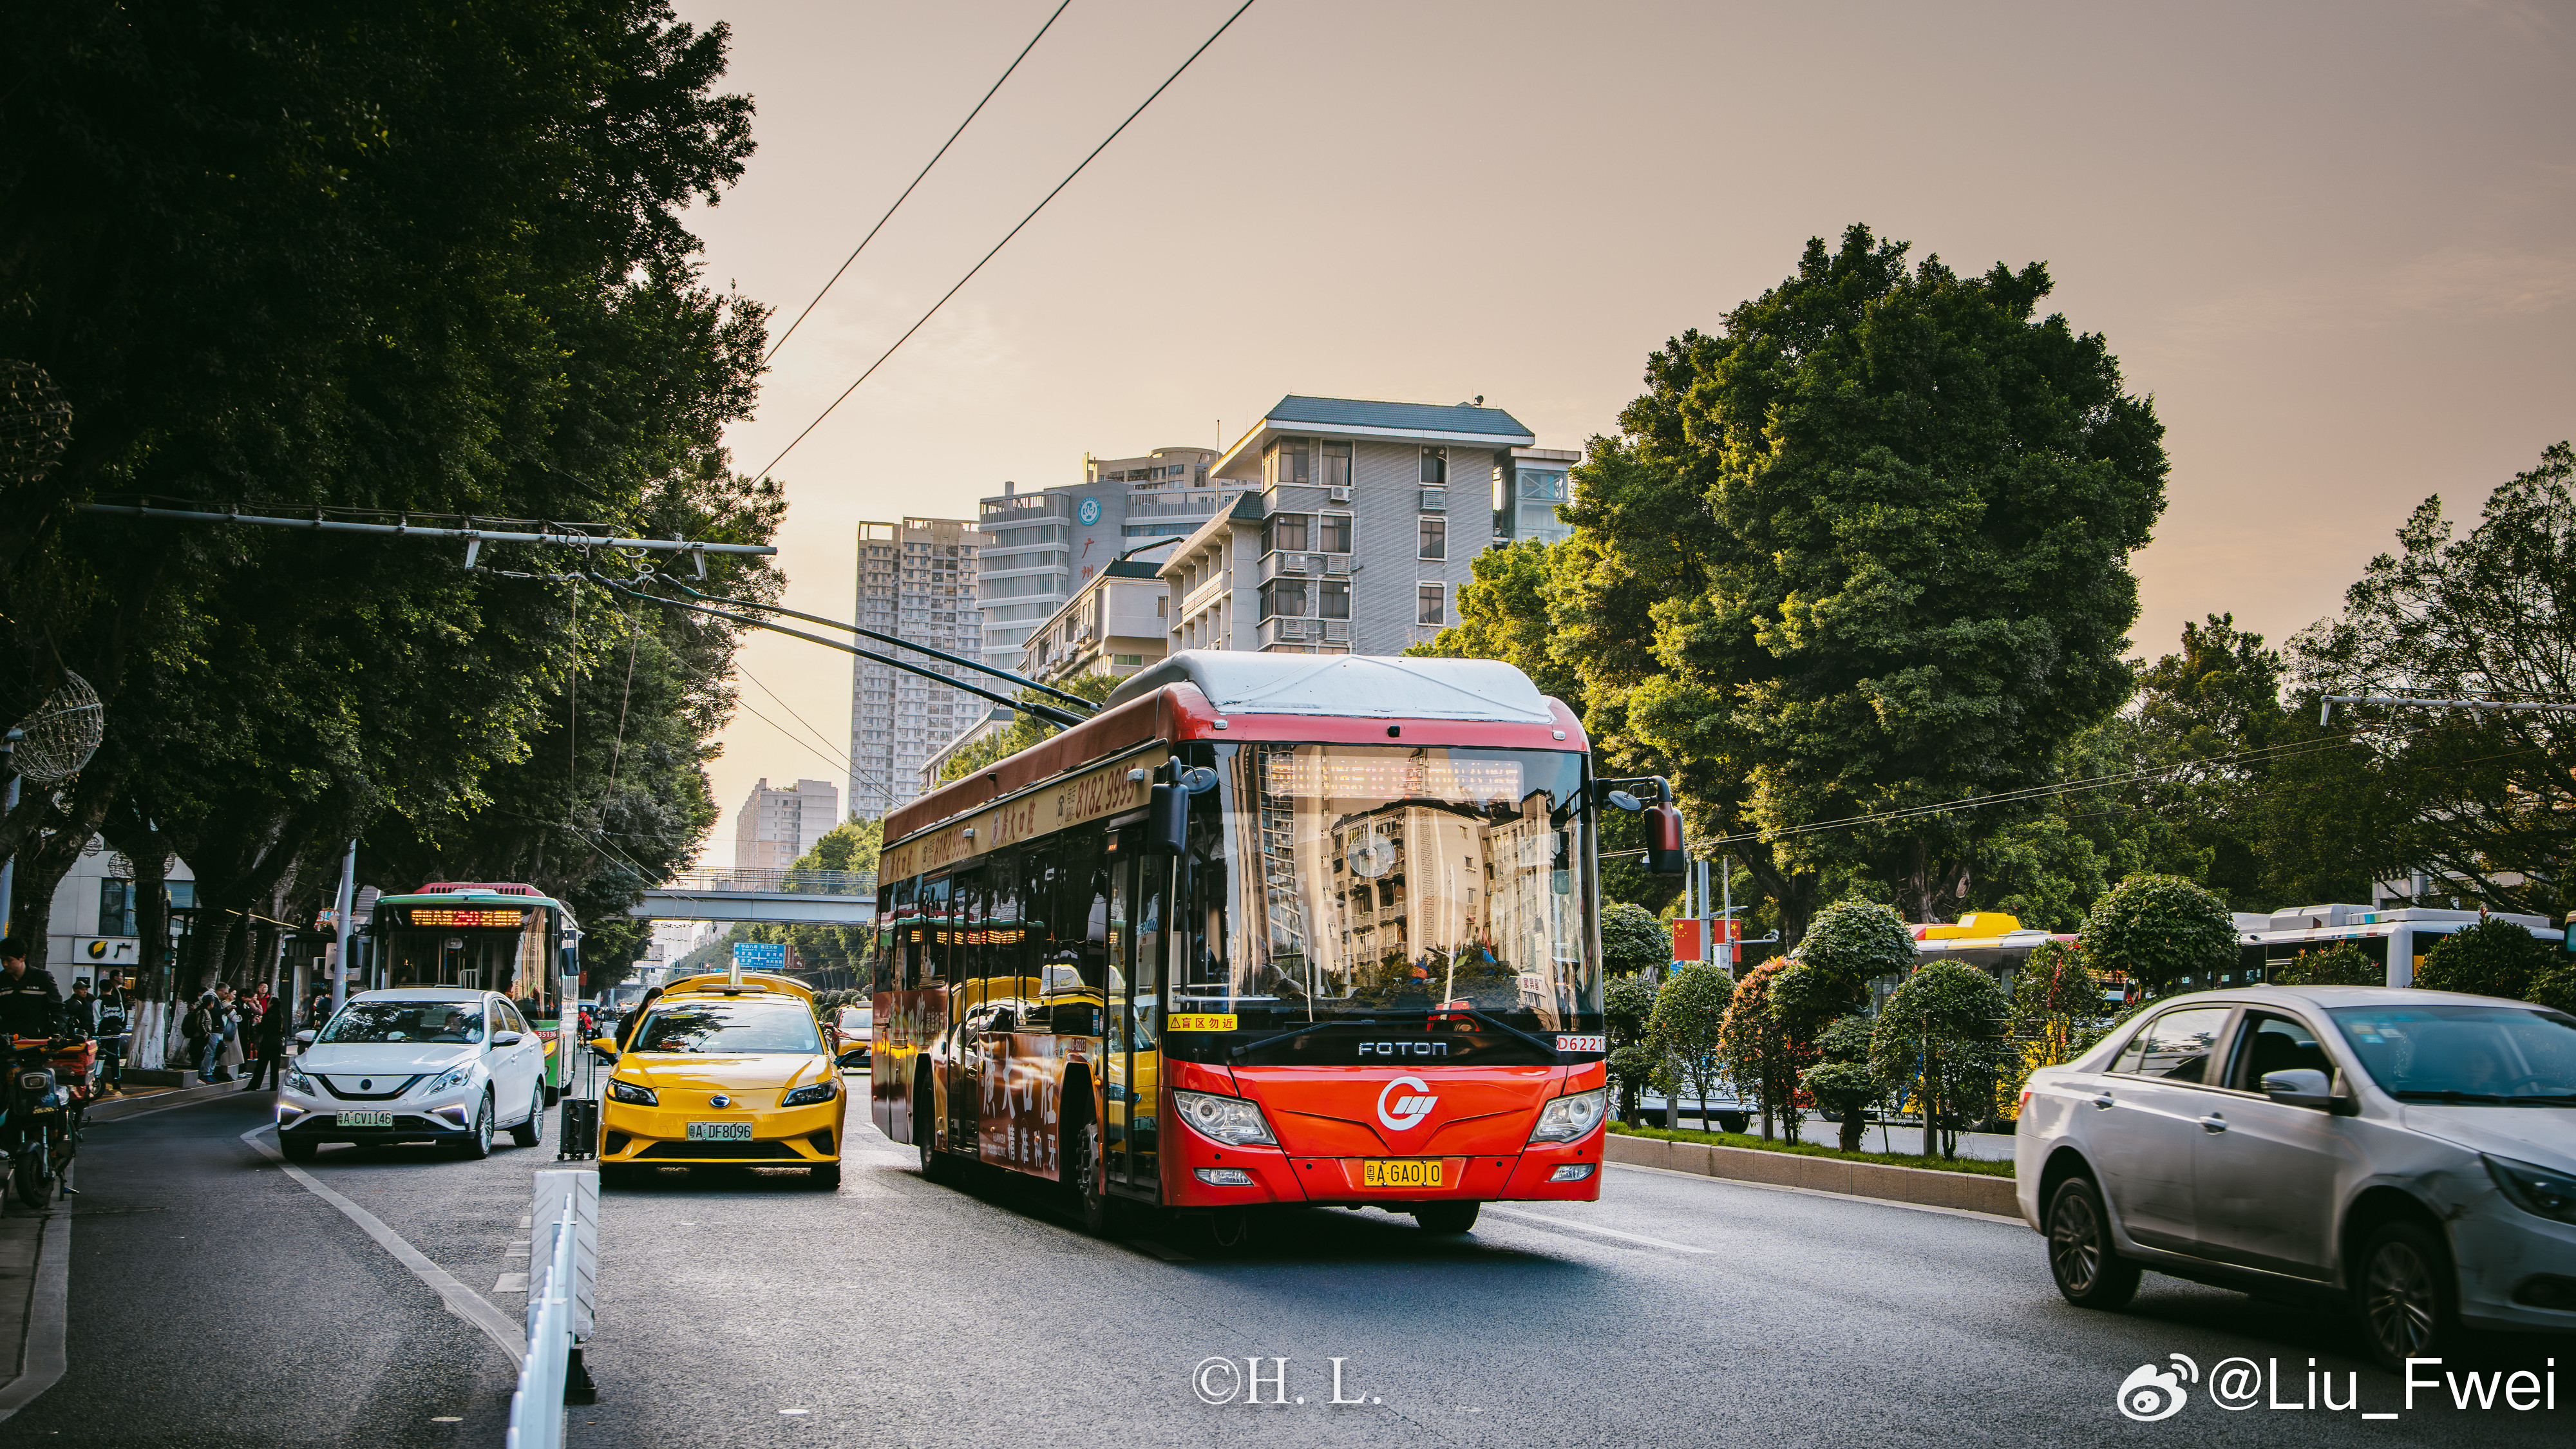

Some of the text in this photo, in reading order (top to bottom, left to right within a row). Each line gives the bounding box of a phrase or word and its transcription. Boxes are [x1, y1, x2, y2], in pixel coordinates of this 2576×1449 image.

[1081, 538, 1094, 580] 广州
[1075, 774, 1104, 819] 8182
[1181, 1018, 1233, 1028] 盲区勿近
[1358, 1042, 1448, 1056] FOTON
[1008, 1124, 1056, 1171] 精准种牙
